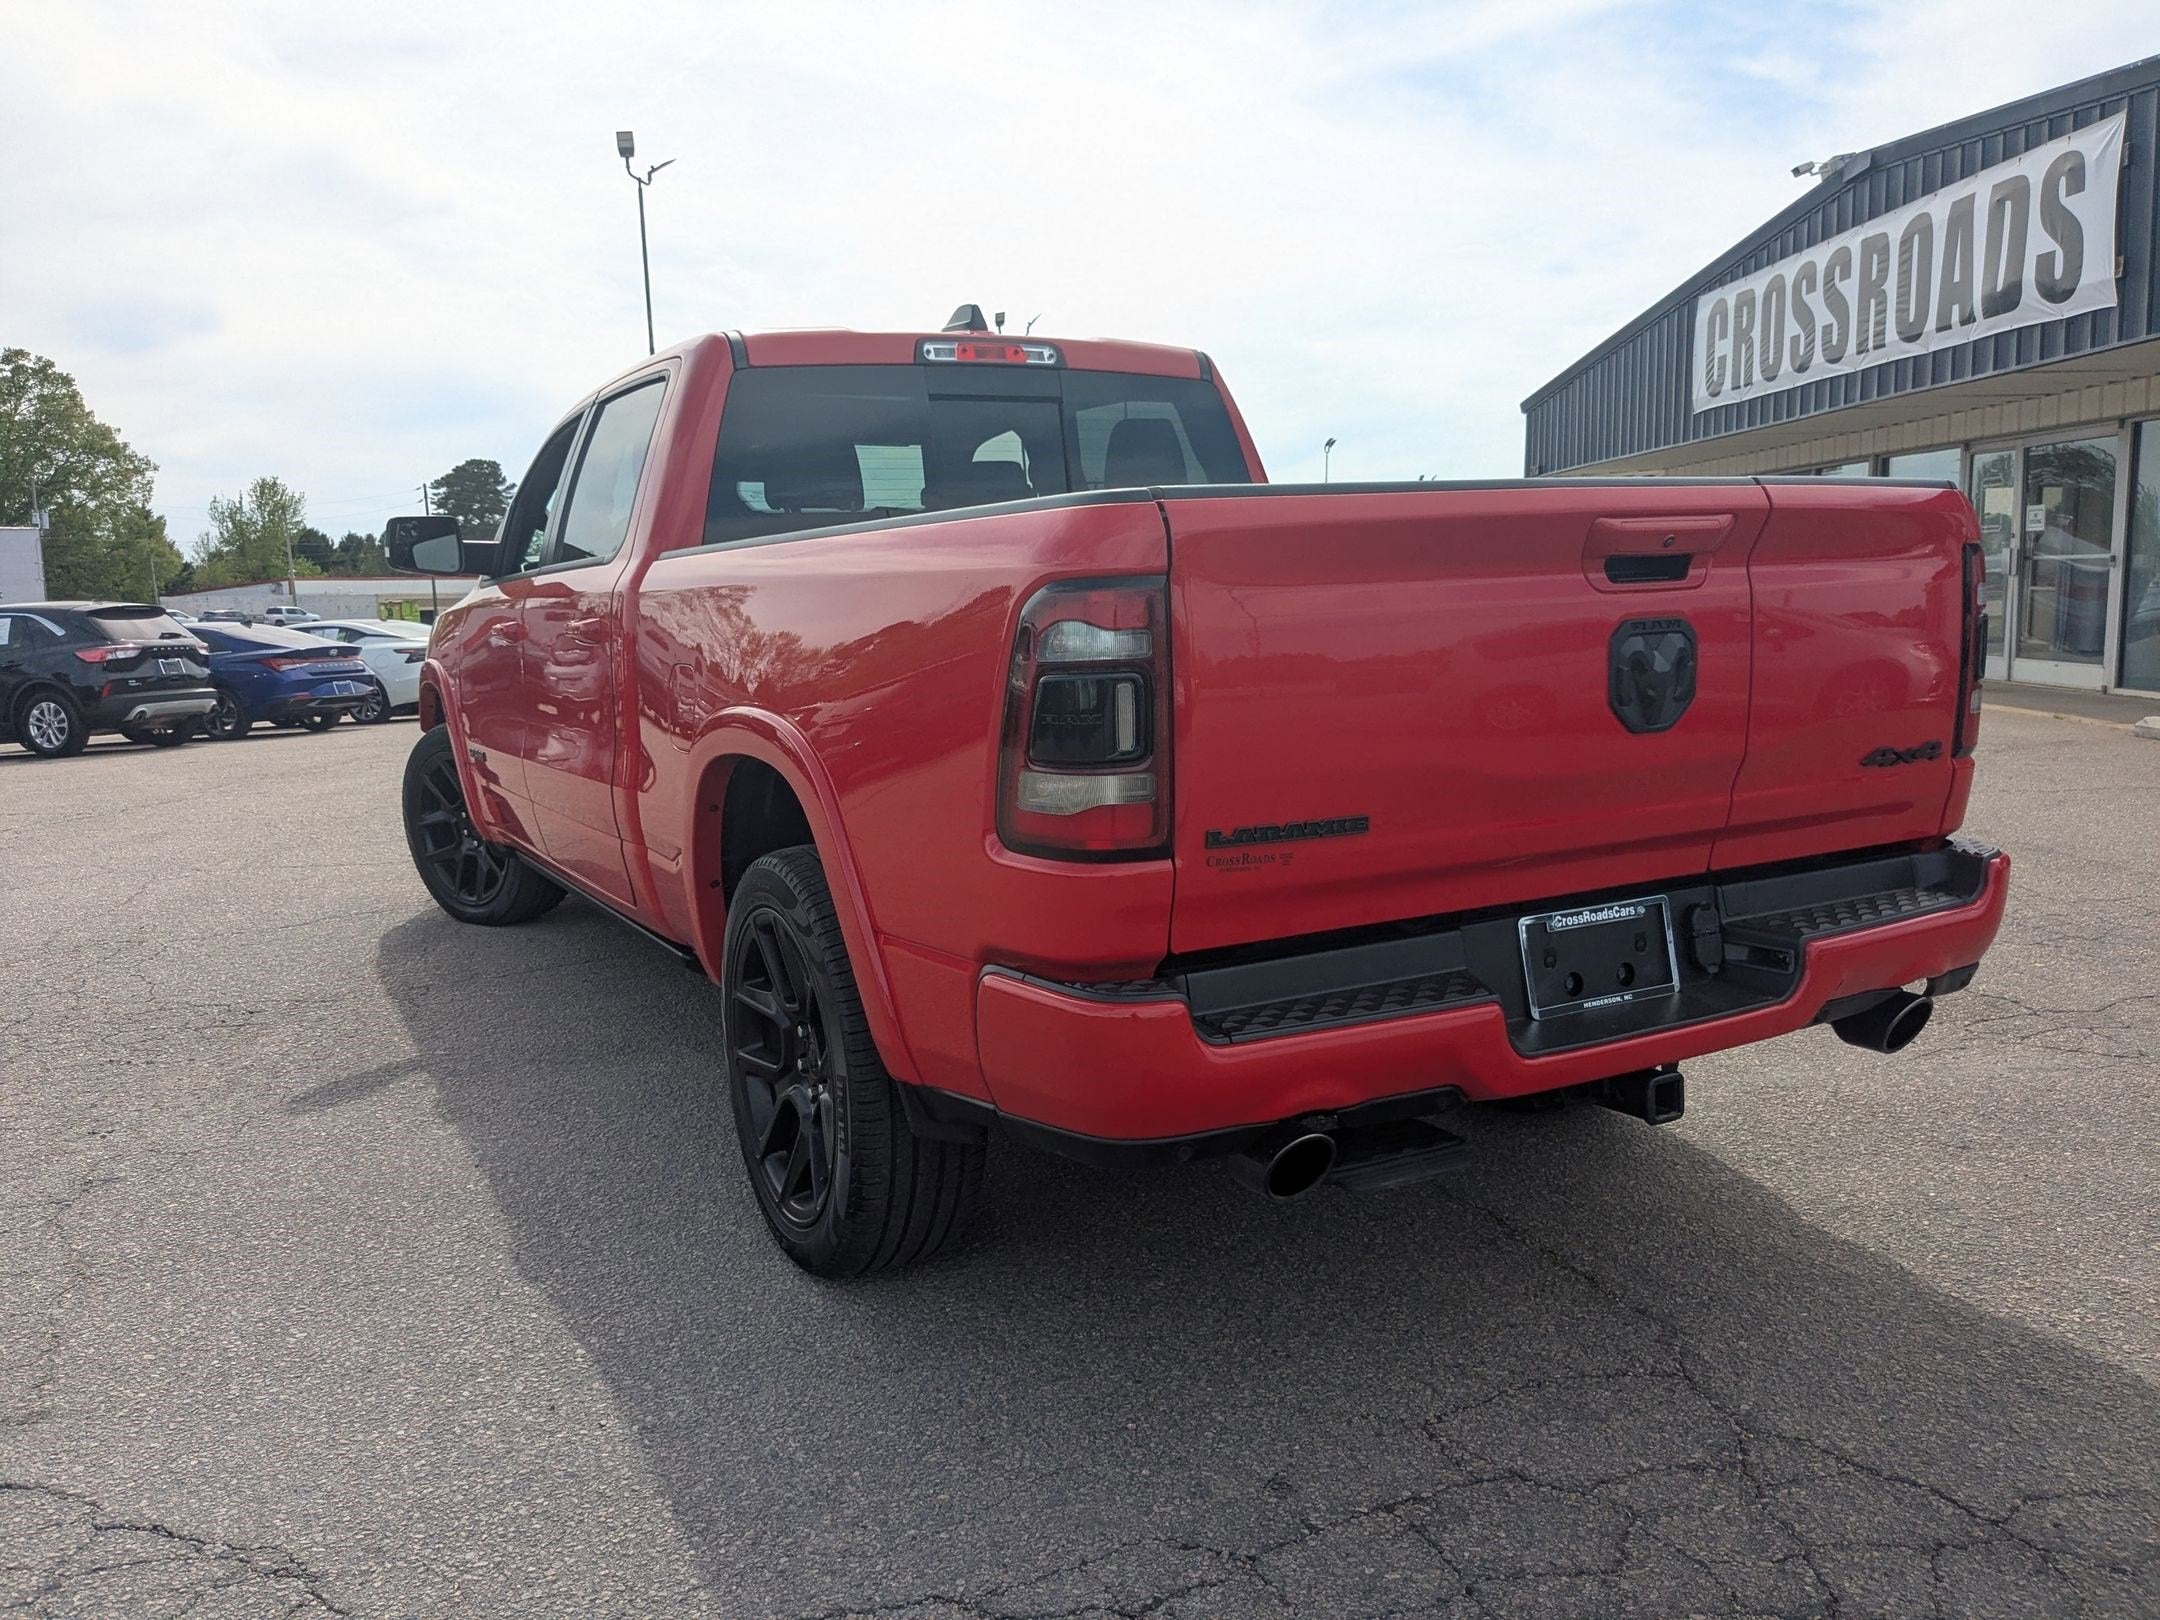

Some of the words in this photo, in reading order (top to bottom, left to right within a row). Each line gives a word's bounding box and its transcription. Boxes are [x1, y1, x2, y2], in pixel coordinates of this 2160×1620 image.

[1704, 149, 2087, 399] CROSSROADS
[1205, 816, 1369, 849] LARAMIE
[1553, 906, 1636, 929] CrossRoadsCars
[1583, 996, 1623, 1008] HENDERSON,
